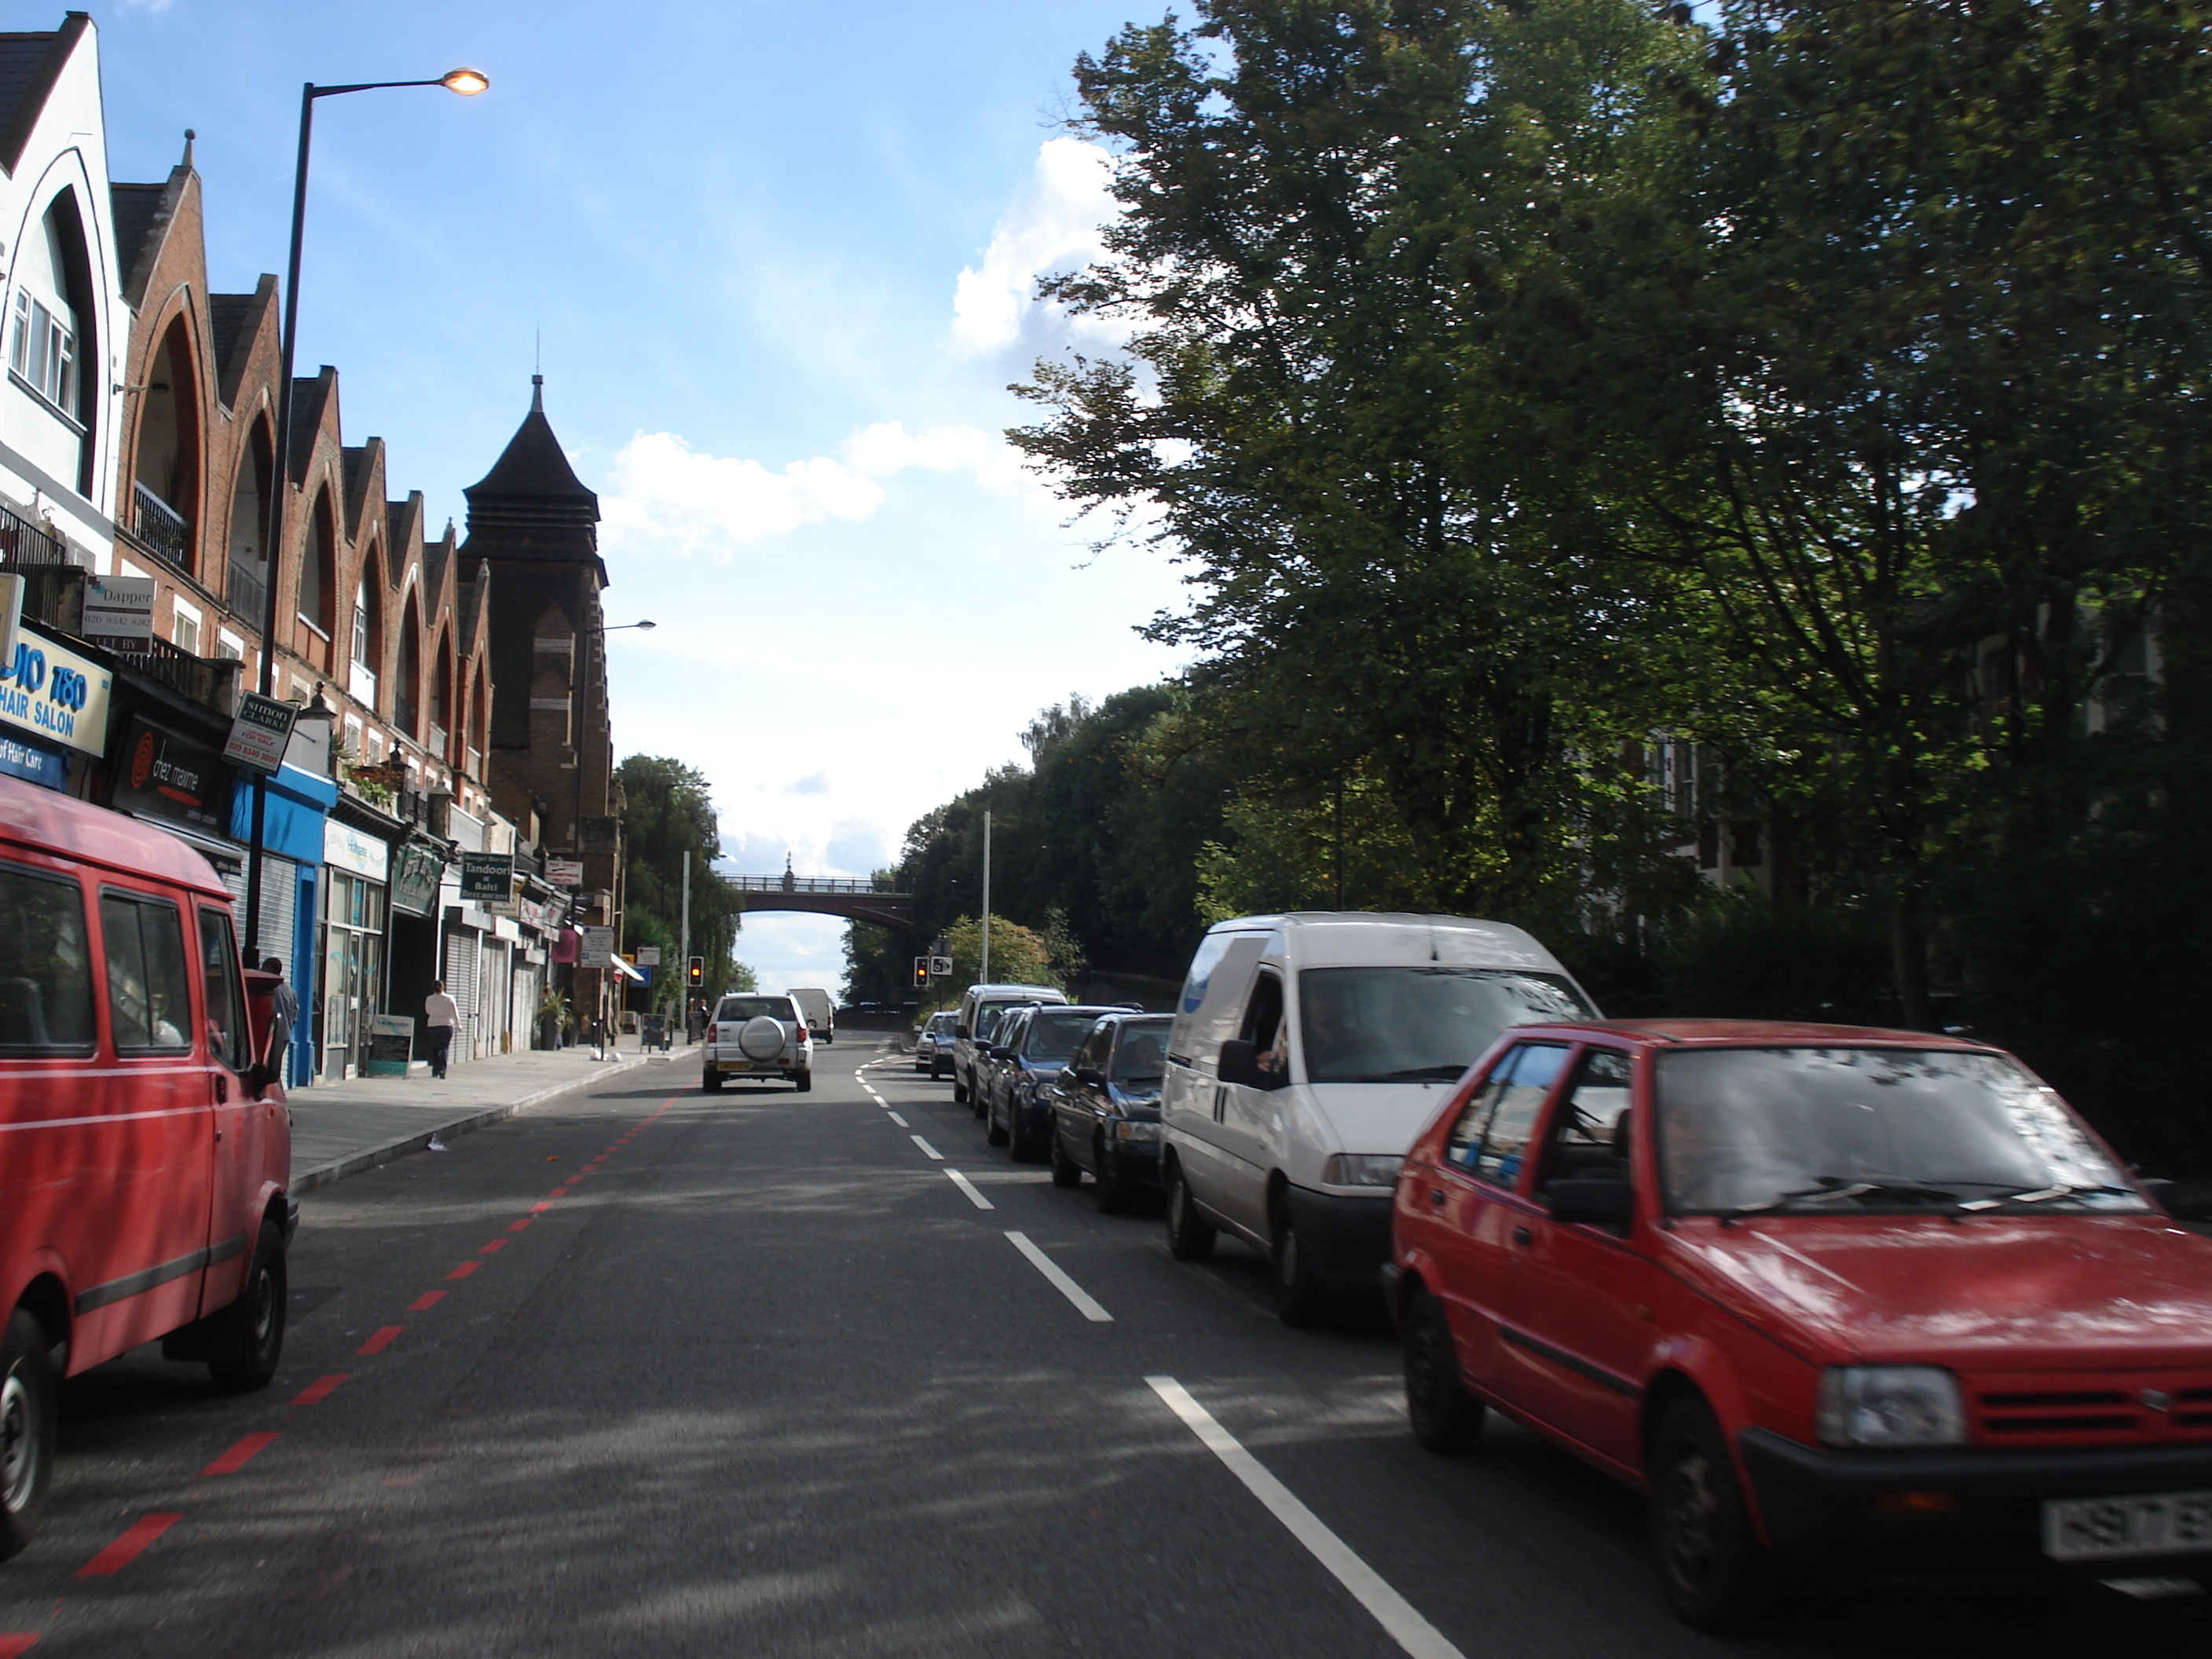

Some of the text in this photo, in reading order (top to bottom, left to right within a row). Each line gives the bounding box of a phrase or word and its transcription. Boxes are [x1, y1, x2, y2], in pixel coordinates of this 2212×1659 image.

[104, 589, 152, 604] Dapper
[96, 638, 137, 649] LET BY
[0, 685, 75, 738] HAIR SALON
[244, 710, 286, 730] CLARKE
[258, 737, 274, 747] SALE
[8, 740, 24, 764] Hair
[25, 747, 42, 771] Care
[153, 739, 171, 781] chez
[465, 862, 511, 875] Tandoori
[474, 882, 498, 892] Balti
[462, 889, 508, 900] Restaurant
